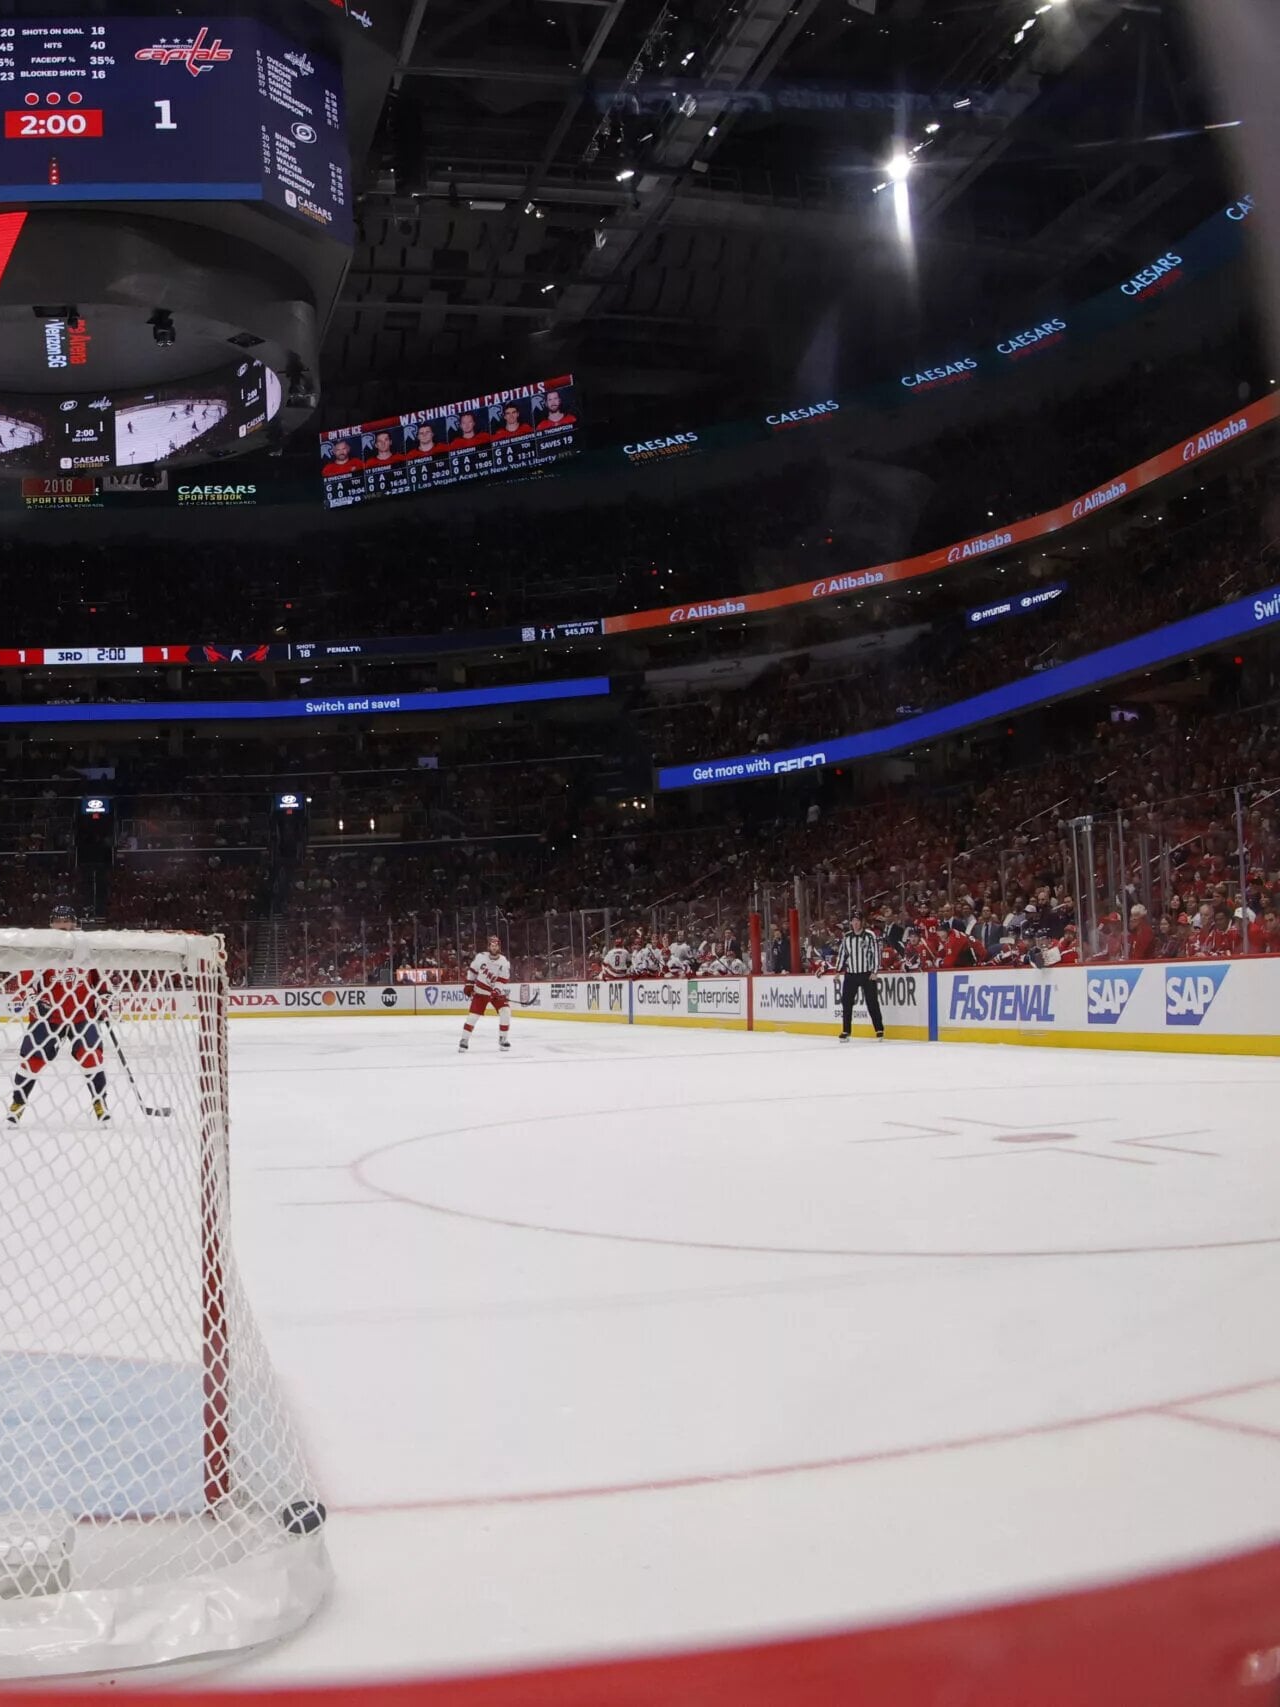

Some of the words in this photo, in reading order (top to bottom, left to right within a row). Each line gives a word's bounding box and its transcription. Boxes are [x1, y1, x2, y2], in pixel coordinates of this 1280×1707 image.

[0, 28, 15, 37] 20
[91, 26, 106, 36] 18
[0, 42, 14, 52] 45
[90, 41, 106, 50] 40
[90, 56, 115, 66] 35%
[0, 72, 15, 81] 23
[20, 70, 58, 78] BLOCKED
[59, 69, 87, 77] SHOTS
[91, 70, 106, 80] 16
[20, 114, 87, 135] 2:00
[154, 100, 177, 129] 1
[297, 196, 332, 221] CAESARS
[1120, 252, 1183, 297] CAESARS
[45, 322, 66, 355] Verizon
[996, 318, 1067, 355] CAESARS
[901, 357, 978, 388] CAESARS
[399, 398, 480, 428] WASHINGTON
[484, 382, 546, 407] CAPITALS
[766, 400, 839, 425] CAESARS
[75, 429, 95, 438] 2:00
[328, 430, 338, 441] ON
[338, 427, 352, 438] THE
[352, 424, 363, 435] ICE
[1196, 416, 1248, 455] Alibaba
[540, 440, 561, 450] SAVES
[563, 436, 574, 445] 19
[623, 432, 699, 455] CAESARS
[73, 455, 110, 464] CAESARS
[44, 479, 73, 494] 2018
[177, 485, 257, 495] CAESARS
[26, 496, 90, 504] SPORTSBOOK
[1083, 480, 1128, 517] Alibaba
[961, 531, 1013, 559] Alibaba
[827, 570, 884, 594] Alibaba
[686, 601, 745, 621] Alibaba
[982, 603, 1011, 618] HYUNDAI
[18, 650, 26, 663] 1
[58, 651, 82, 662] 3RD
[96, 648, 126, 661] 2:00
[161, 648, 169, 660] 1
[300, 649, 311, 658] 18
[306, 701, 345, 713] Switch
[347, 699, 369, 710] and
[371, 698, 400, 709] save!
[693, 767, 713, 781] Get
[715, 764, 744, 777] more
[746, 758, 771, 773] with
[229, 994, 280, 1006] NDA
[285, 990, 366, 1006] DISCOVER
[587, 983, 601, 1011] CAT
[609, 983, 623, 1011] CAT
[637, 985, 660, 1005] Great
[661, 984, 681, 1010] Clips
[688, 986, 740, 1009] enterprise
[770, 986, 828, 1009] MassMutual
[949, 975, 1055, 1022] FASTENAL
[1088, 977, 1129, 1015] SAP
[1166, 976, 1215, 1016] SAP
